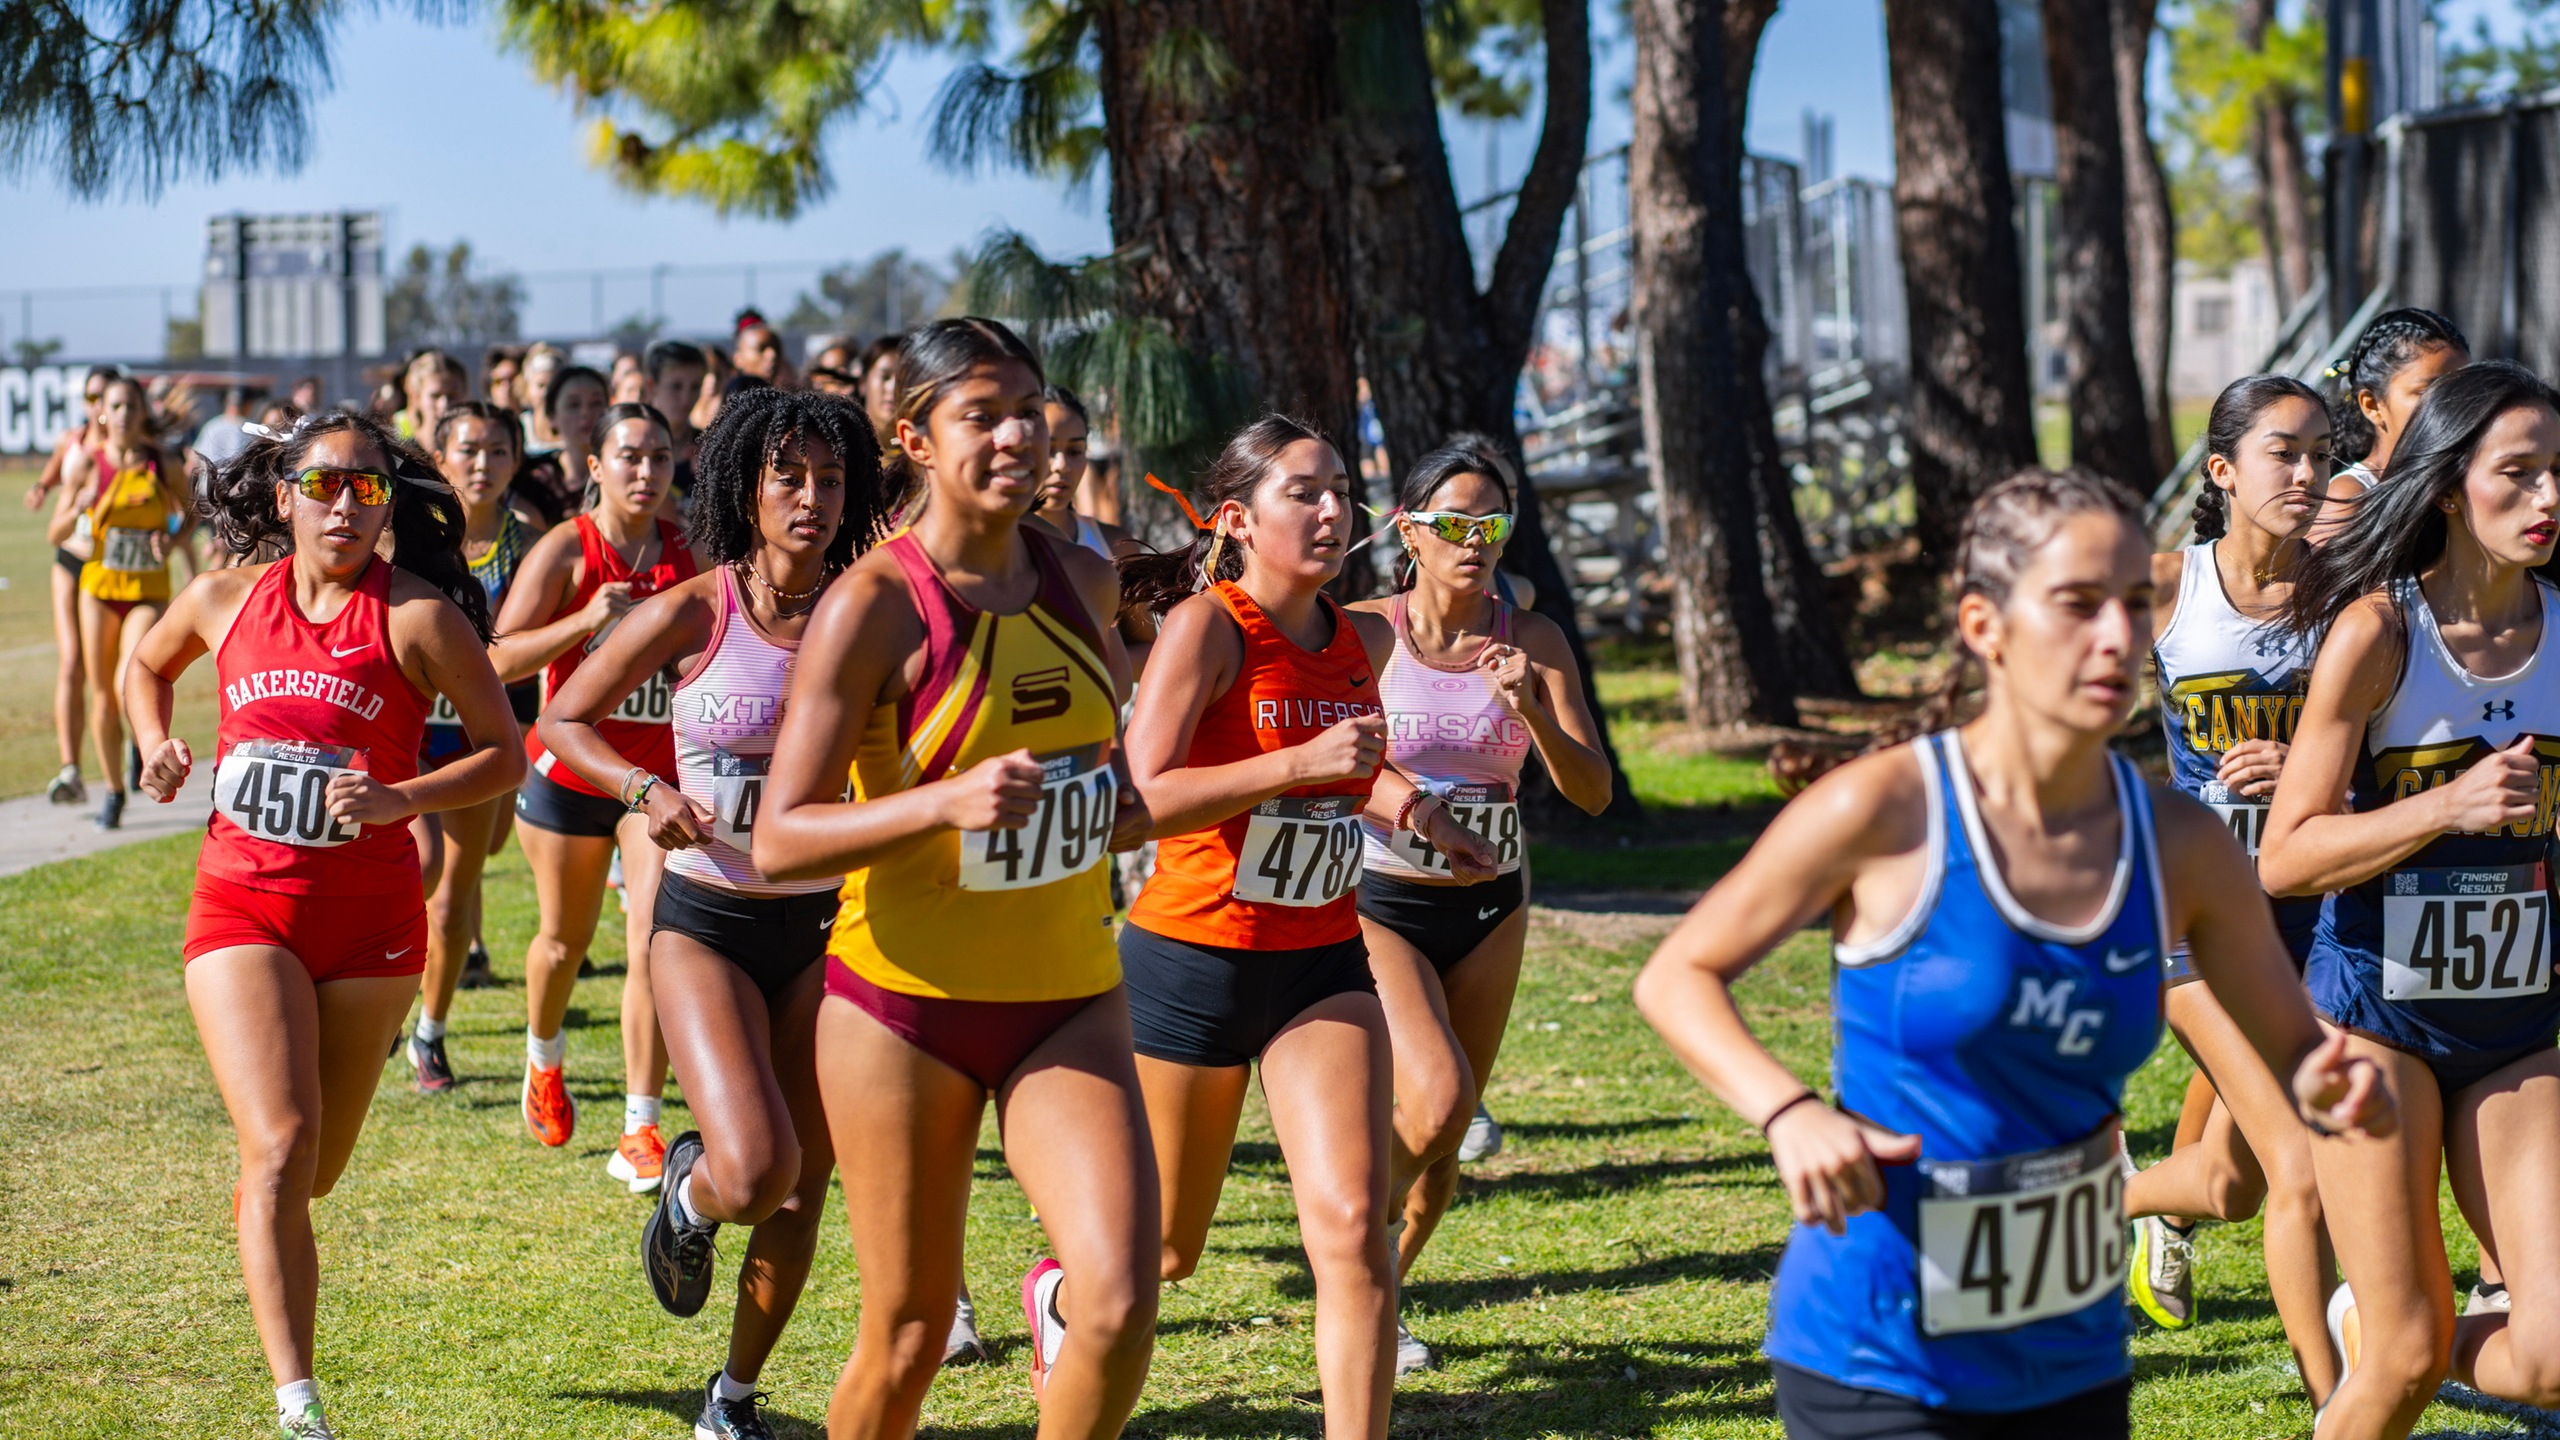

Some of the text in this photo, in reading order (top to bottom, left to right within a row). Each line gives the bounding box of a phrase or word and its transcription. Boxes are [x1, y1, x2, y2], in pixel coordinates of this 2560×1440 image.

[226, 669, 385, 721] BAKERSFIELD
[708, 728, 770, 737] CROSS
[280, 743, 320, 755] FINISHED
[277, 752, 317, 764] RESULTS
[1257, 818, 1364, 900] 4782
[2461, 872, 2509, 883] FINISHED
[2458, 883, 2506, 894] RESULTS
[2409, 895, 2547, 991] 4527
[1960, 1164, 2123, 1315] 4703
